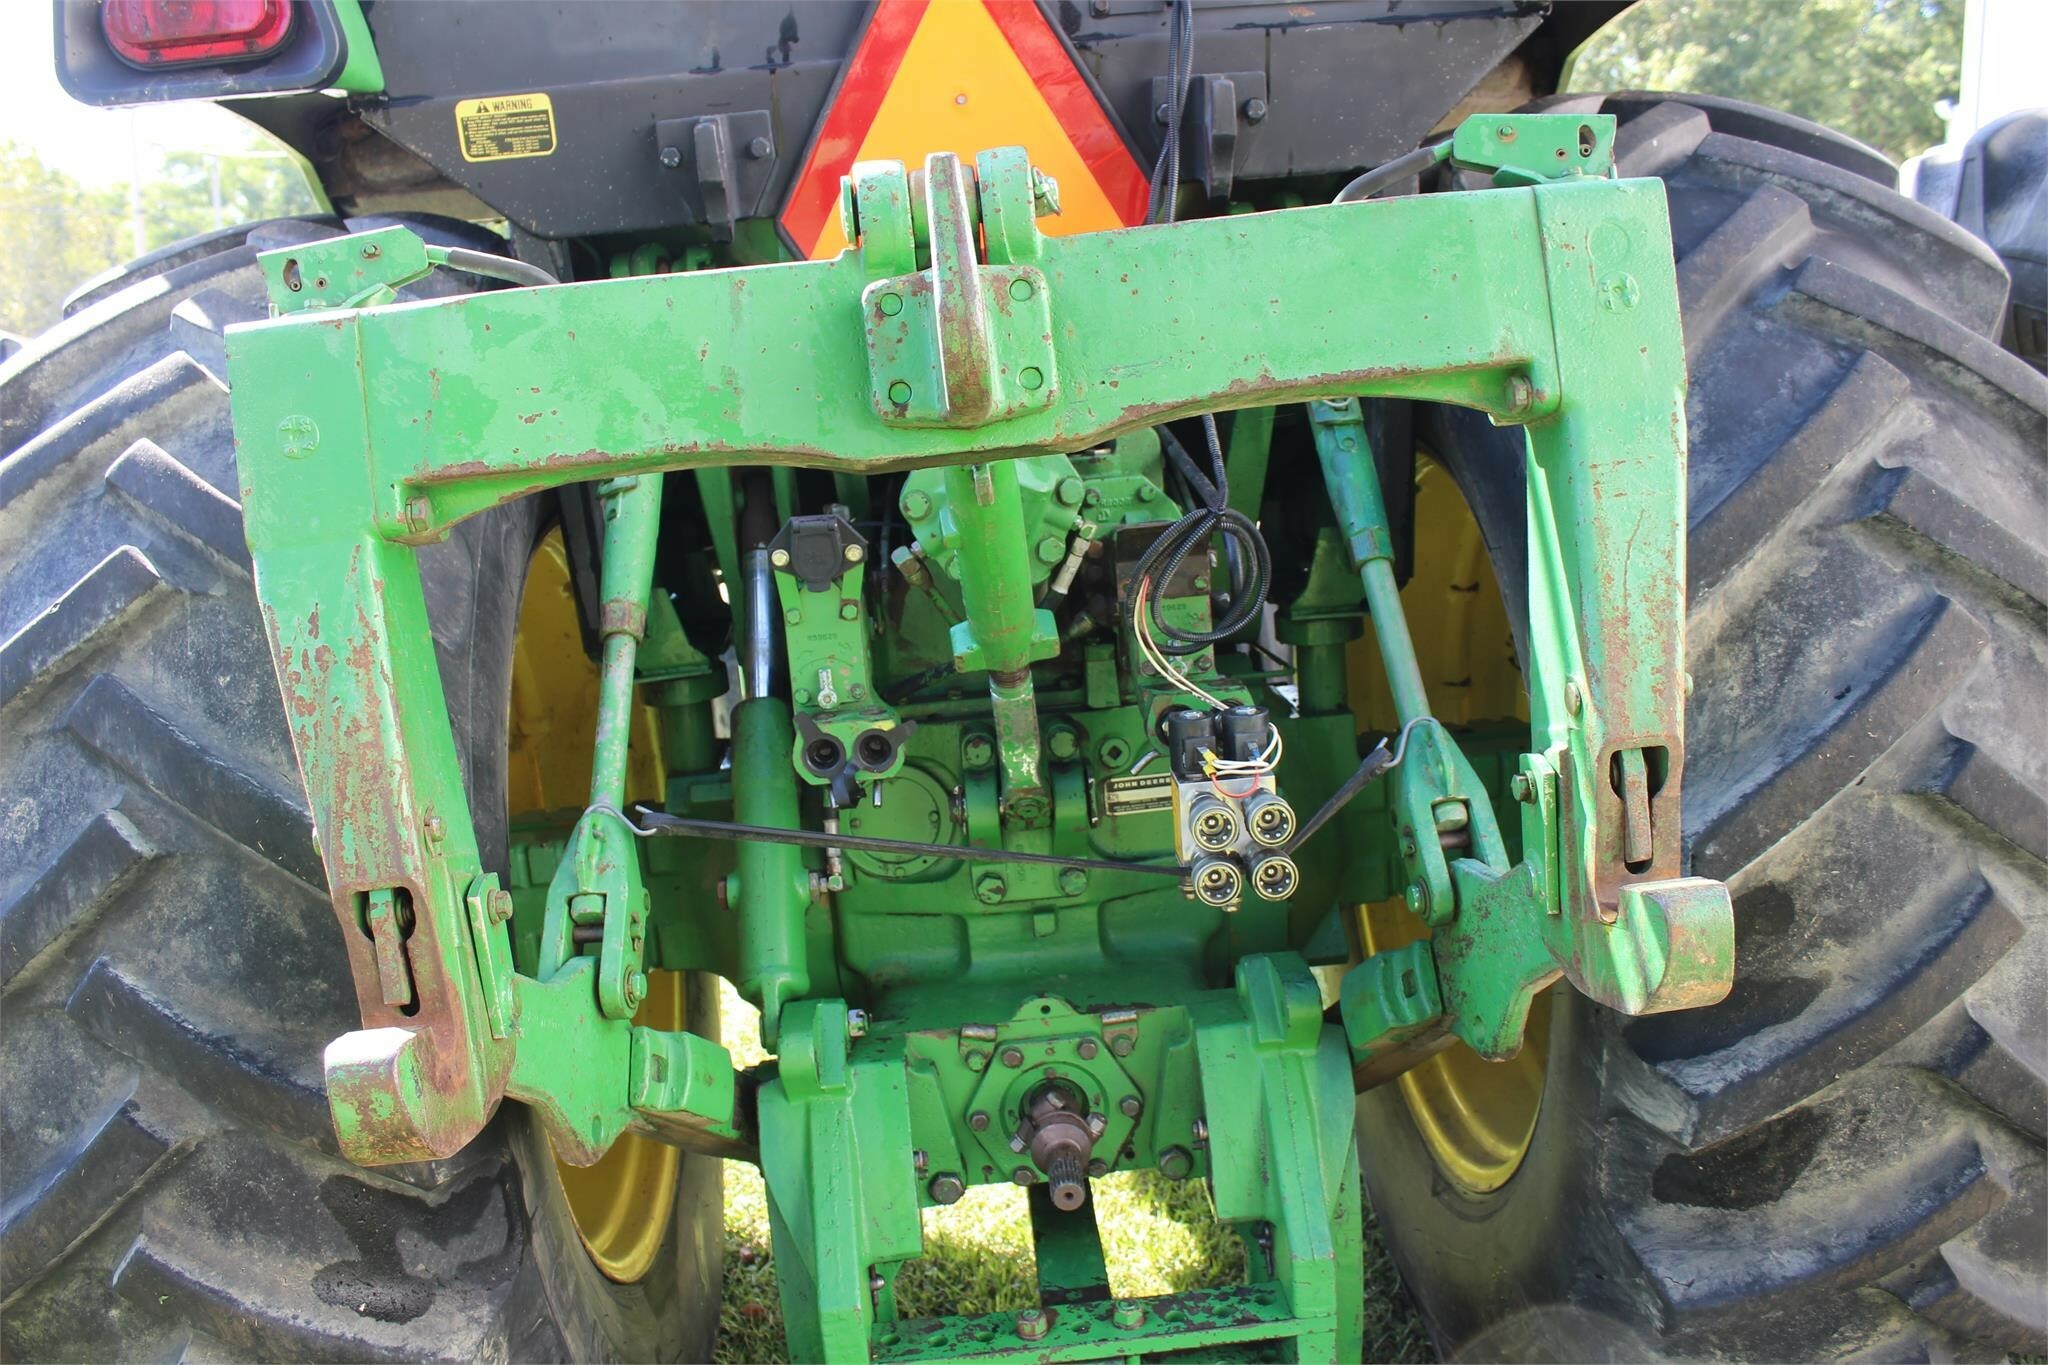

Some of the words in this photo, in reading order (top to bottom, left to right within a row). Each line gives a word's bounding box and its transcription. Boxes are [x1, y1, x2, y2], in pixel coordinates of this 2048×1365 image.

[492, 98, 533, 112] WARNING
[1113, 781, 1138, 789] JOHN
[1140, 777, 1171, 786] DEERE
